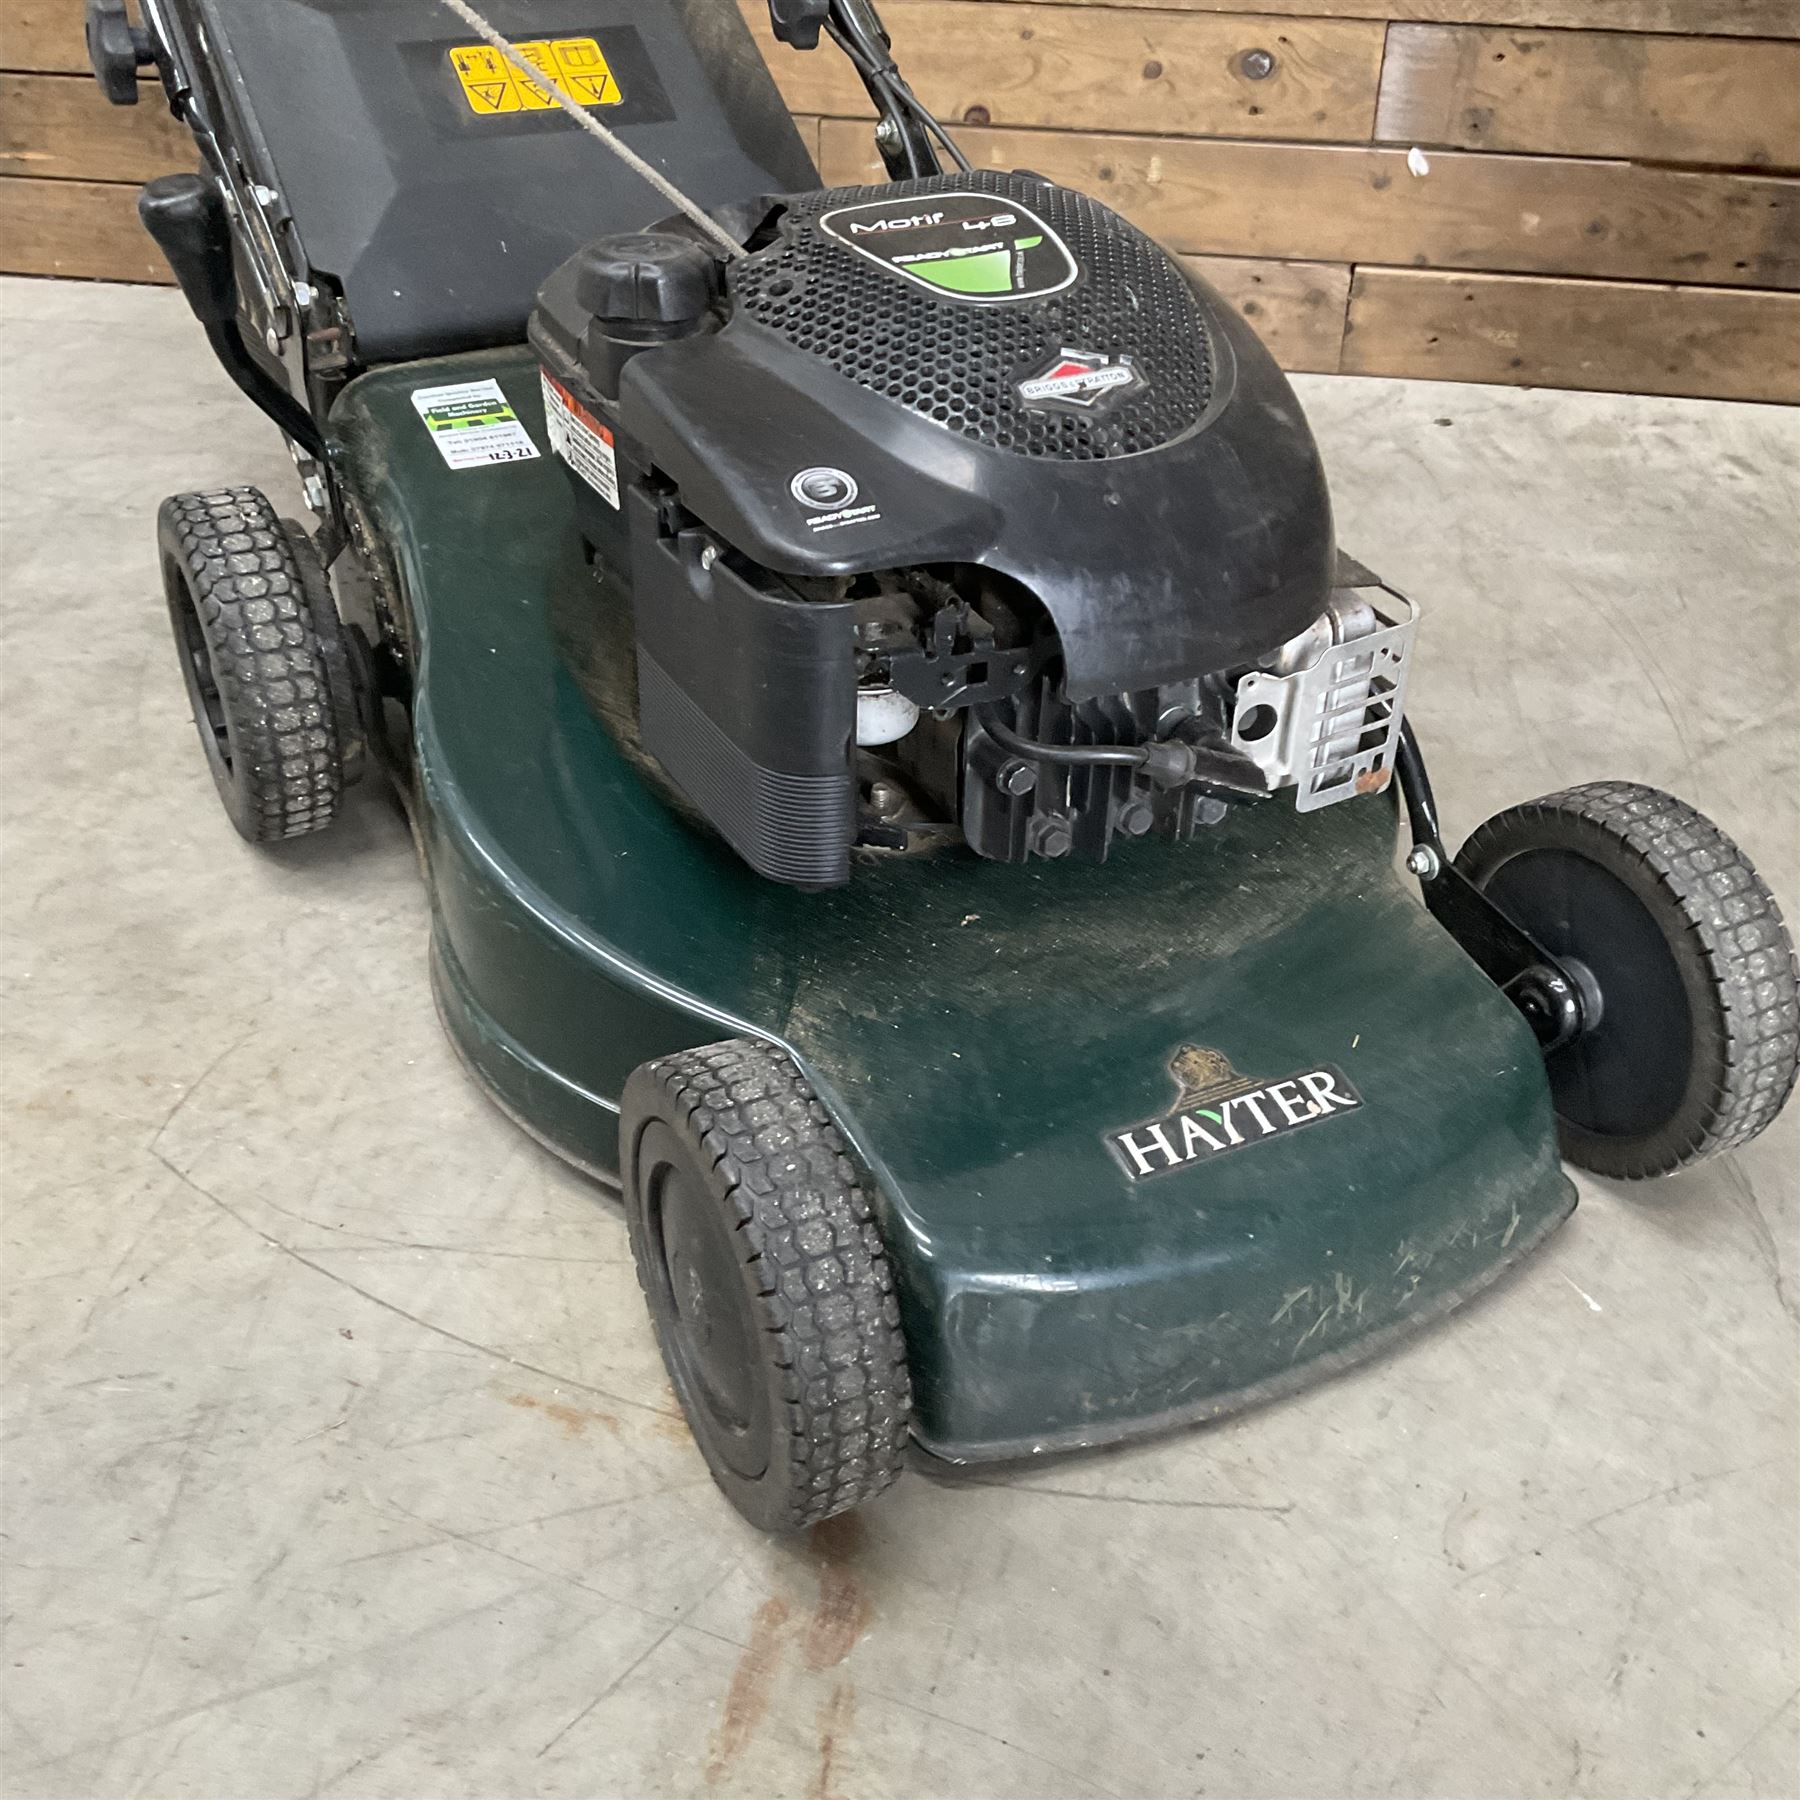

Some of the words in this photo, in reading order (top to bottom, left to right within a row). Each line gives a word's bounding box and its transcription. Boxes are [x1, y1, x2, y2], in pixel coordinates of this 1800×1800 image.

[451, 403, 468, 411] and
[467, 401, 498, 409] Garden
[1117, 1071, 1359, 1175] HAYTER
